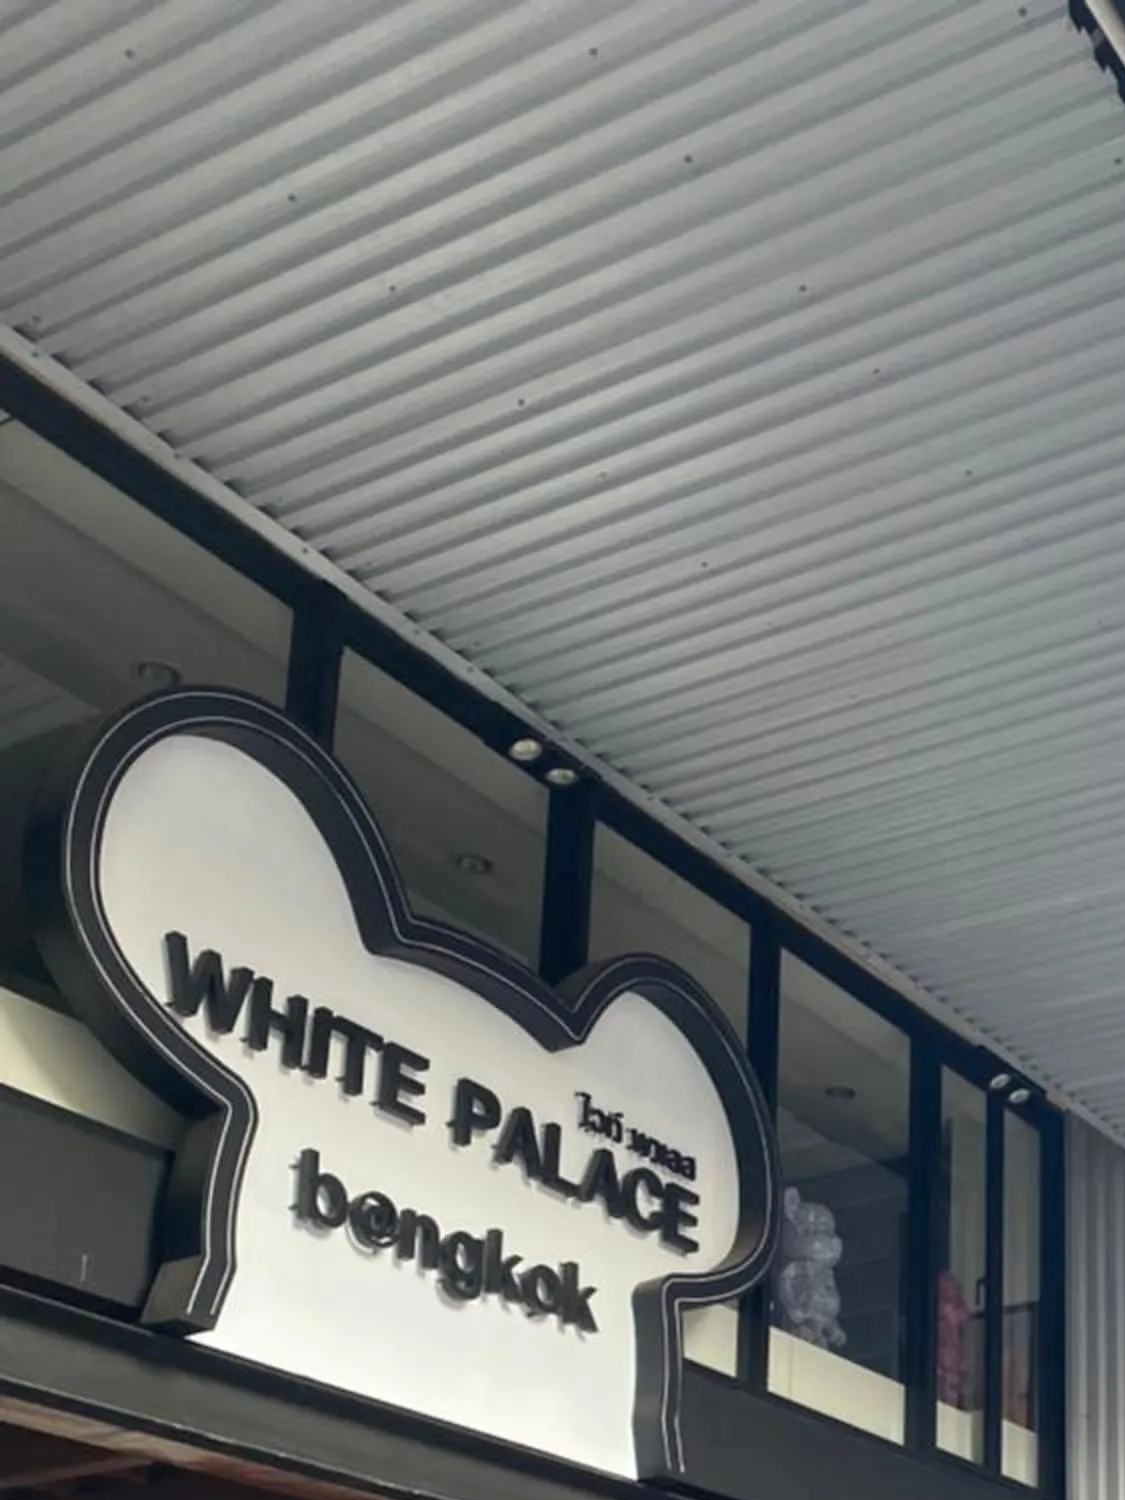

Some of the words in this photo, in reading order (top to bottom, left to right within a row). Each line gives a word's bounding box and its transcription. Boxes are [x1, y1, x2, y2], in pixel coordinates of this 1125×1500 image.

[165, 931, 430, 1127] WHITE
[446, 1077, 700, 1257] PALACE
[290, 1148, 599, 1334] b@ngkok
